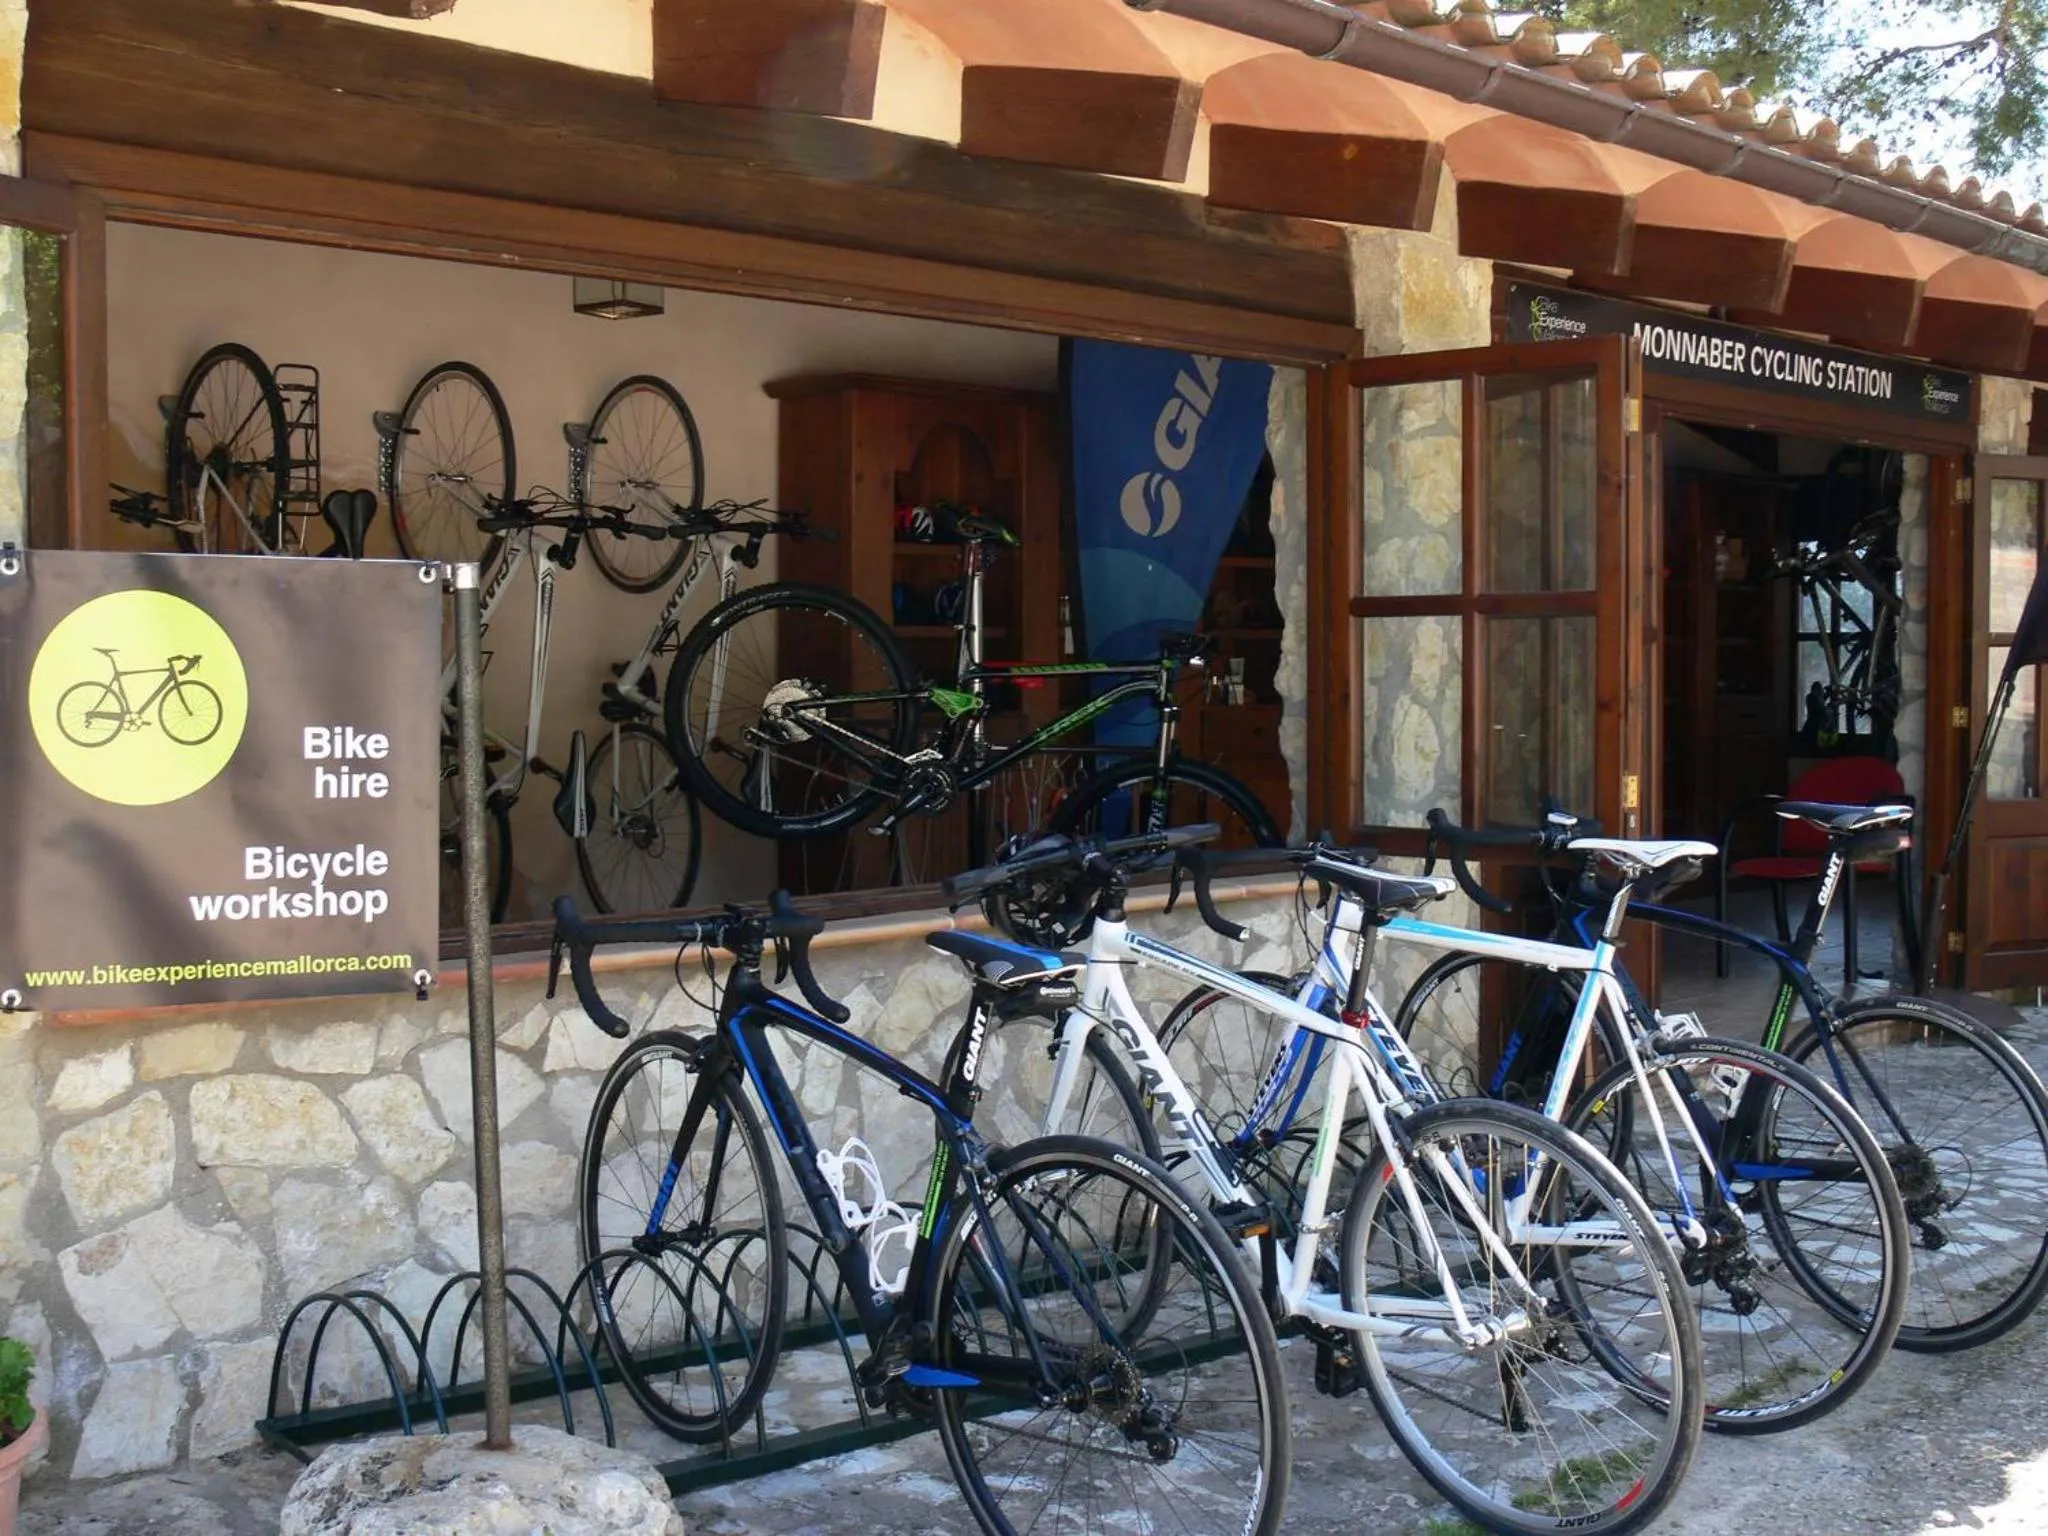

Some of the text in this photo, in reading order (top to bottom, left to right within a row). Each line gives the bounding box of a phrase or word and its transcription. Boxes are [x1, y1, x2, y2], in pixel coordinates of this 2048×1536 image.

[1634, 322, 1892, 399] MONNABER CYCLING STATION
[303, 726, 390, 759] Bike
[314, 766, 390, 798] hire
[244, 843, 389, 886] Bicycle
[1817, 851, 1841, 906] GIANT
[189, 884, 389, 922] workshop
[25, 951, 412, 987] www.bikeexperiencemallorca.com
[963, 1006, 987, 1081] GIANT
[1111, 1018, 1203, 1148] GIANT
[1113, 1153, 1151, 1177] GIANT
[1574, 1231, 1629, 1241] STEVEN
